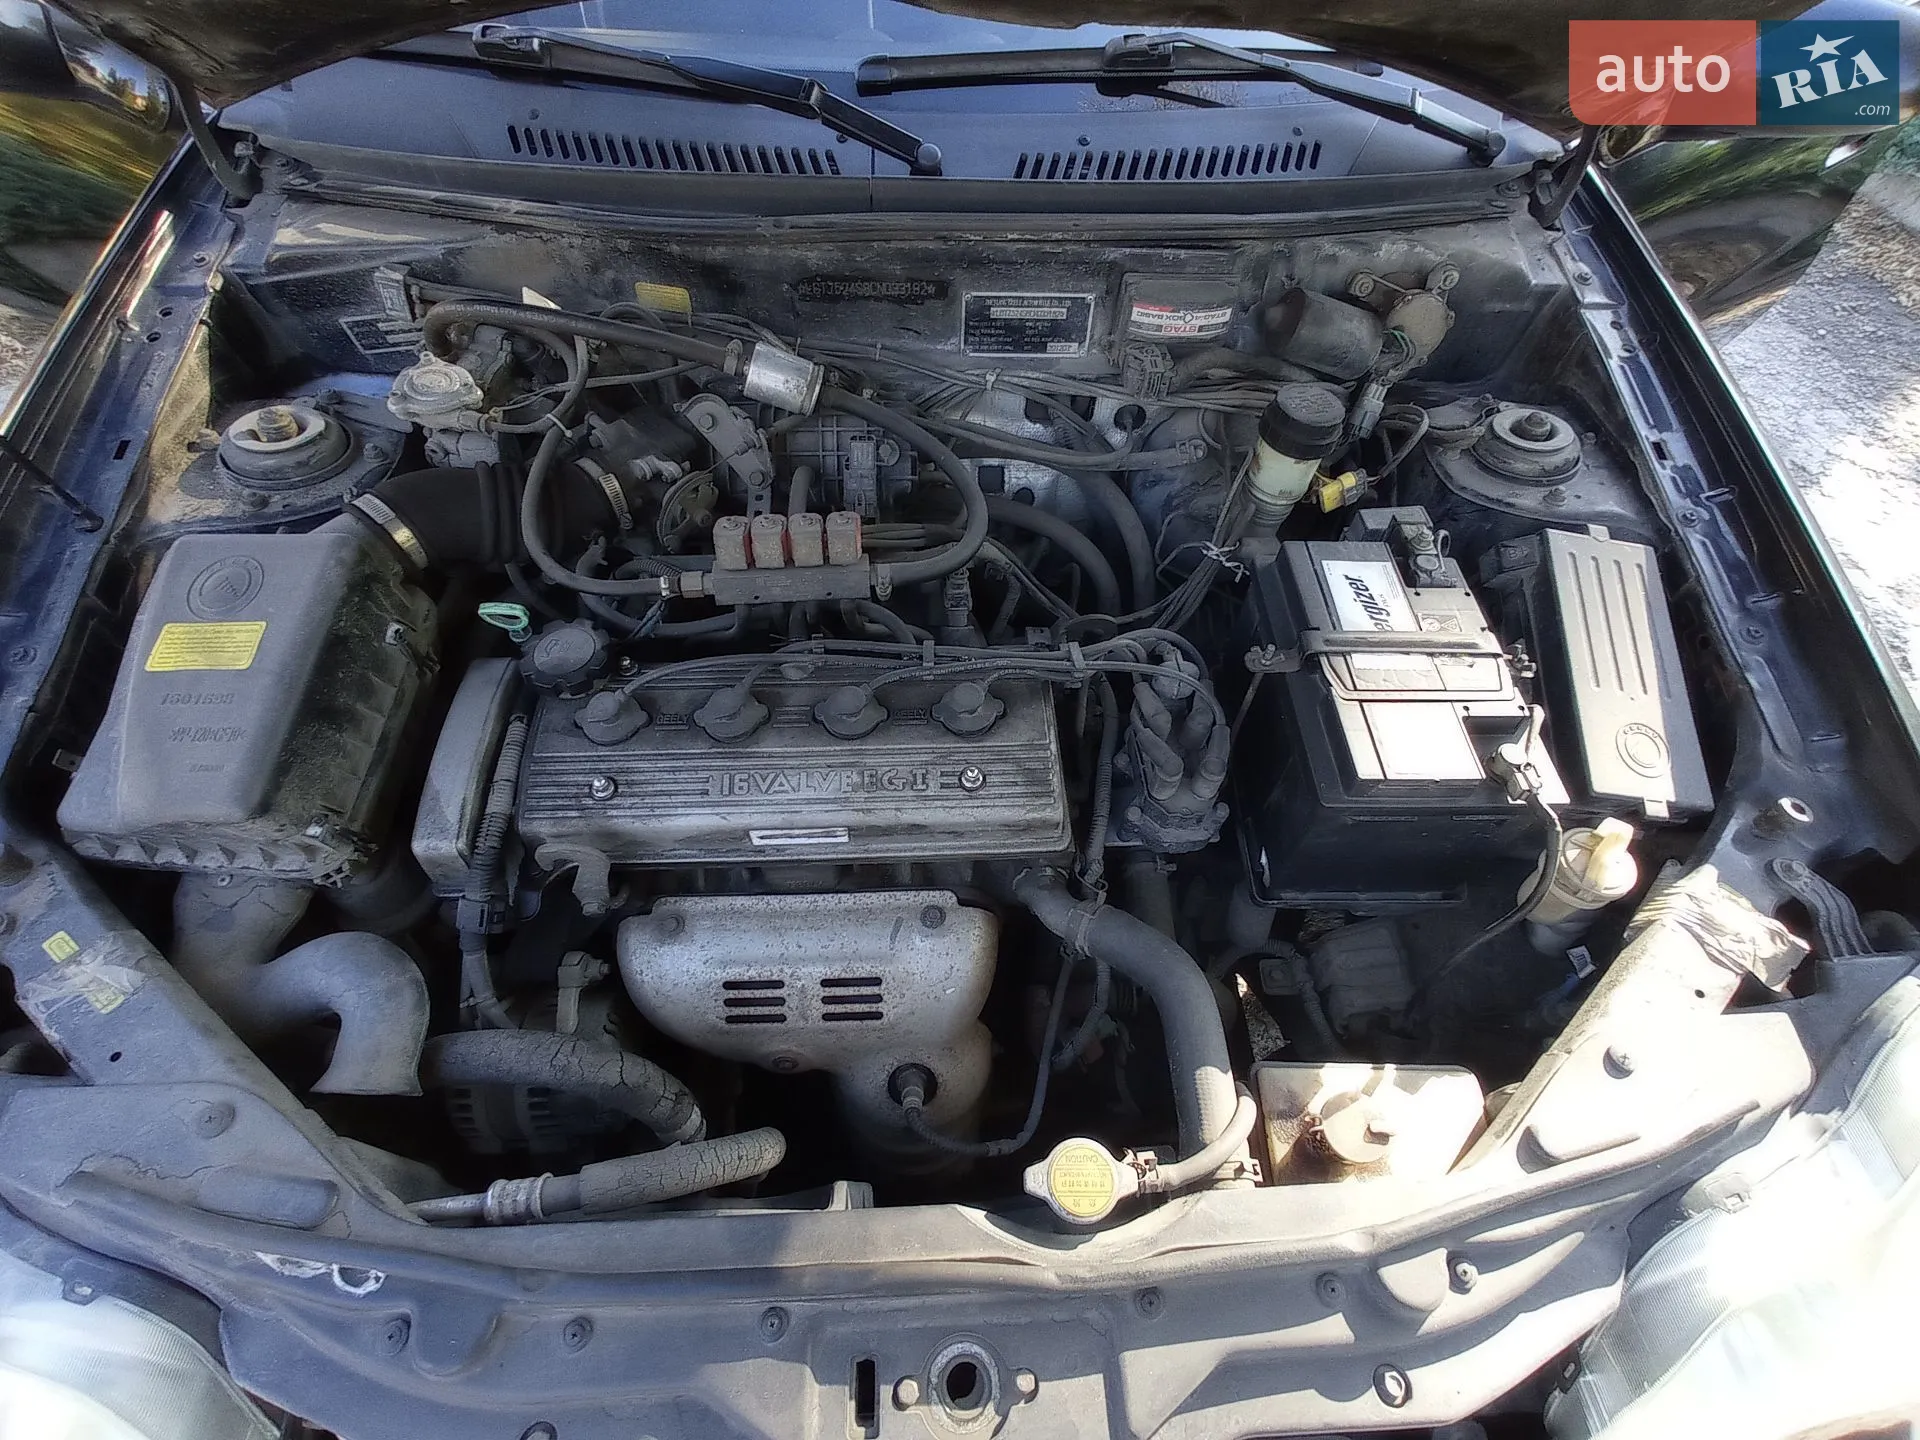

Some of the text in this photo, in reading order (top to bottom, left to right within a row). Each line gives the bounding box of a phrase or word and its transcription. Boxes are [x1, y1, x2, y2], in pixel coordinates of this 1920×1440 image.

[1164, 325, 1197, 334] STAG
[1342, 573, 1394, 632] ergizer
[1065, 1154, 1099, 1164] CAUTION
